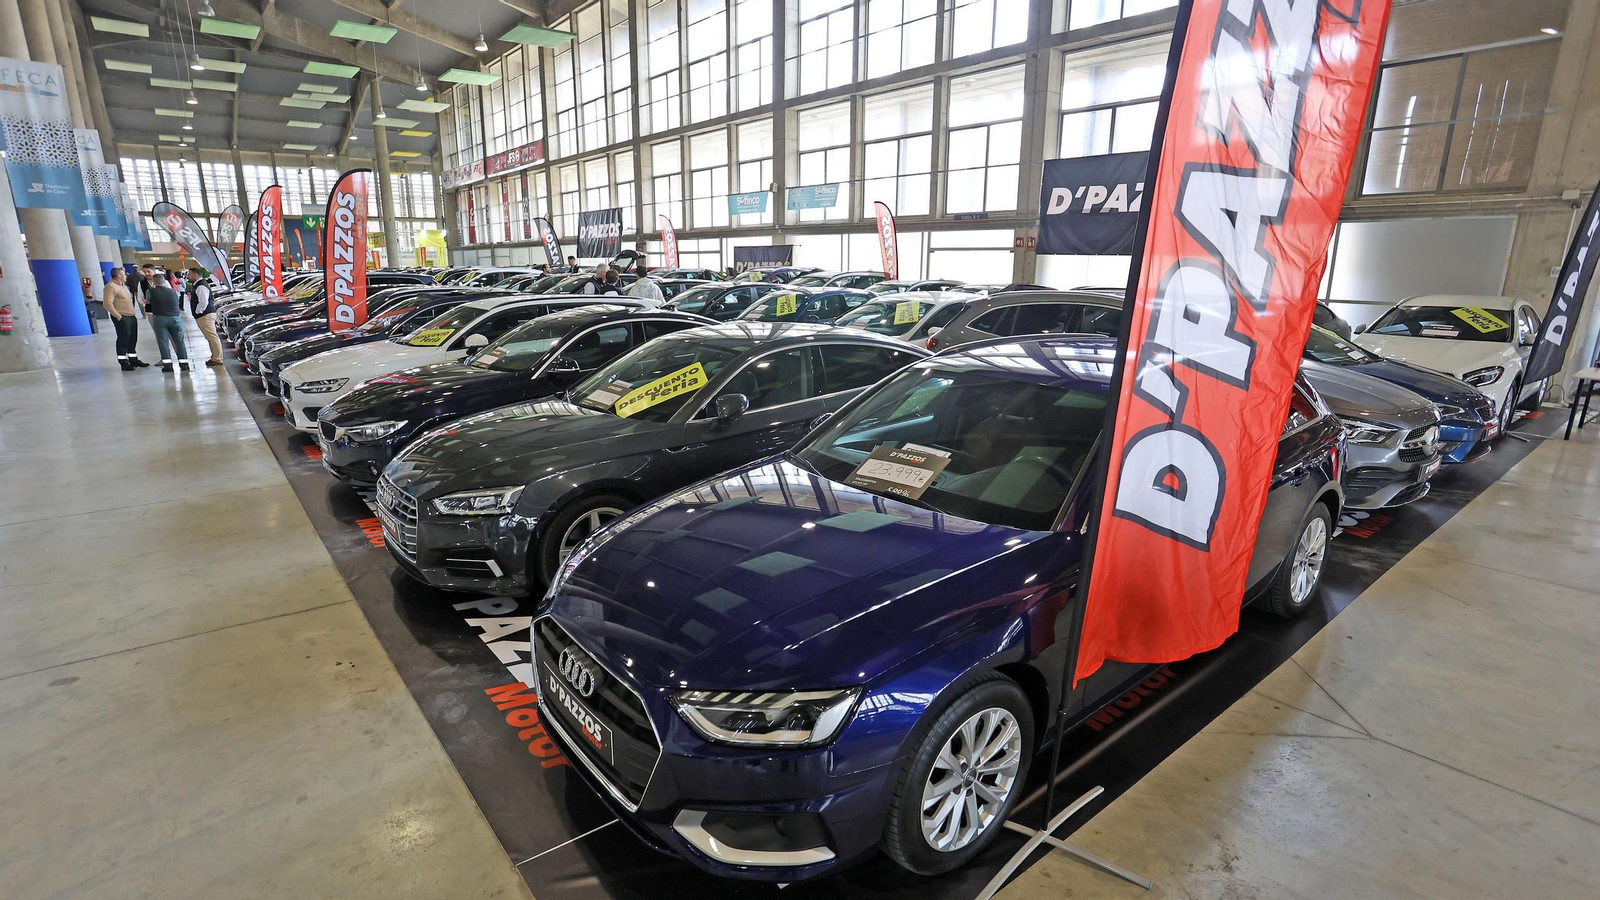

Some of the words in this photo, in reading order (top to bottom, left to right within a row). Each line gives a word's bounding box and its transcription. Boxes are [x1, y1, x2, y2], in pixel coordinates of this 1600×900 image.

[736, 196, 760, 206] Sofinco
[580, 222, 621, 239] D'PAZZOS
[261, 204, 278, 298] D'PAZZOS
[334, 190, 356, 324] D'PAZZOS
[1461, 307, 1503, 329] DESCUENTO
[1467, 315, 1491, 330] Feria
[619, 367, 700, 410] DESCUENTO
[650, 376, 699, 402] Feria
[889, 451, 927, 463] D'PAZZOS
[868, 462, 928, 483] 23.999€
[550, 675, 602, 742] D'PAZZOS
